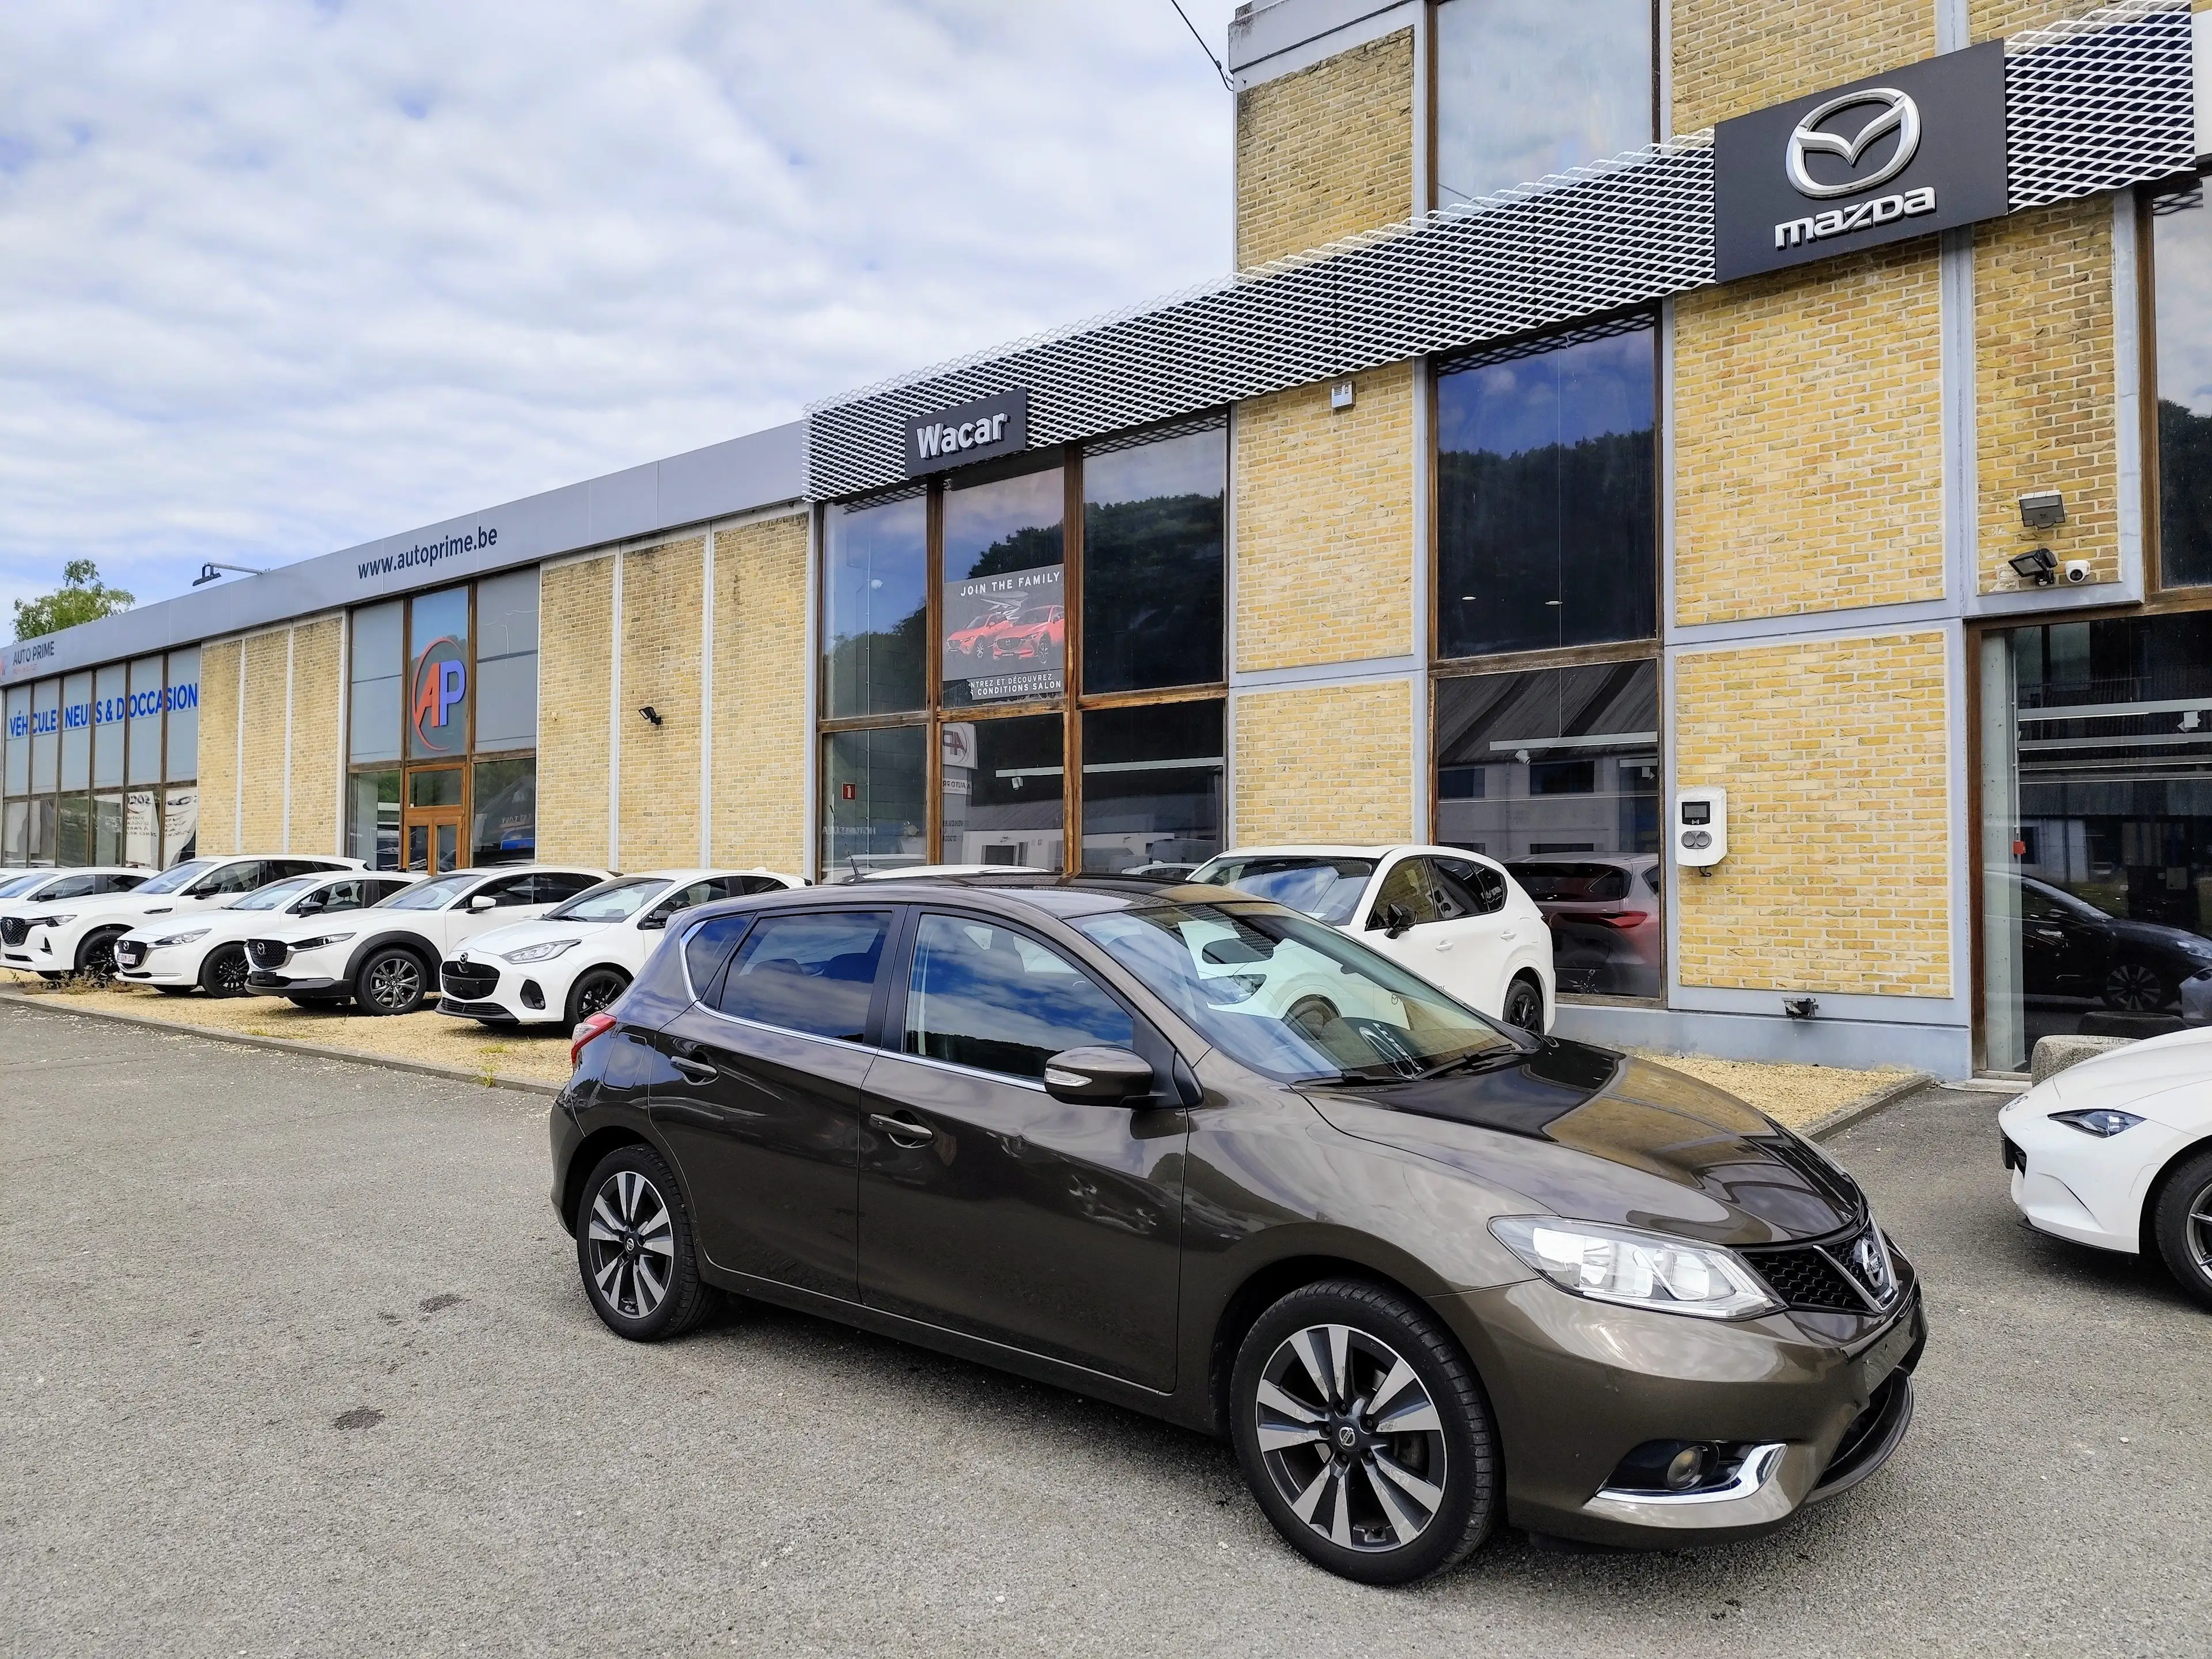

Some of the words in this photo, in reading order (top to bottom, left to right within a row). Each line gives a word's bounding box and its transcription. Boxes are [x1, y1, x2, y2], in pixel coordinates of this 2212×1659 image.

[916, 412, 1009, 459] Wacar
[358, 525, 498, 579] www.autoprime.be
[960, 583, 986, 597] JOIN
[991, 578, 1013, 592] THE
[1018, 571, 1060, 588] FAMILY
[13, 647, 31, 666] AUTO
[32, 641, 54, 661] PRIME
[969, 679, 994, 688] NTREZ
[1008, 673, 1052, 684] DÉCOUVREZ
[977, 683, 1029, 696] CONDITIONS
[1032, 680, 1061, 690] SALON
[10, 709, 60, 737] VÉHCULE
[105, 699, 113, 722] &
